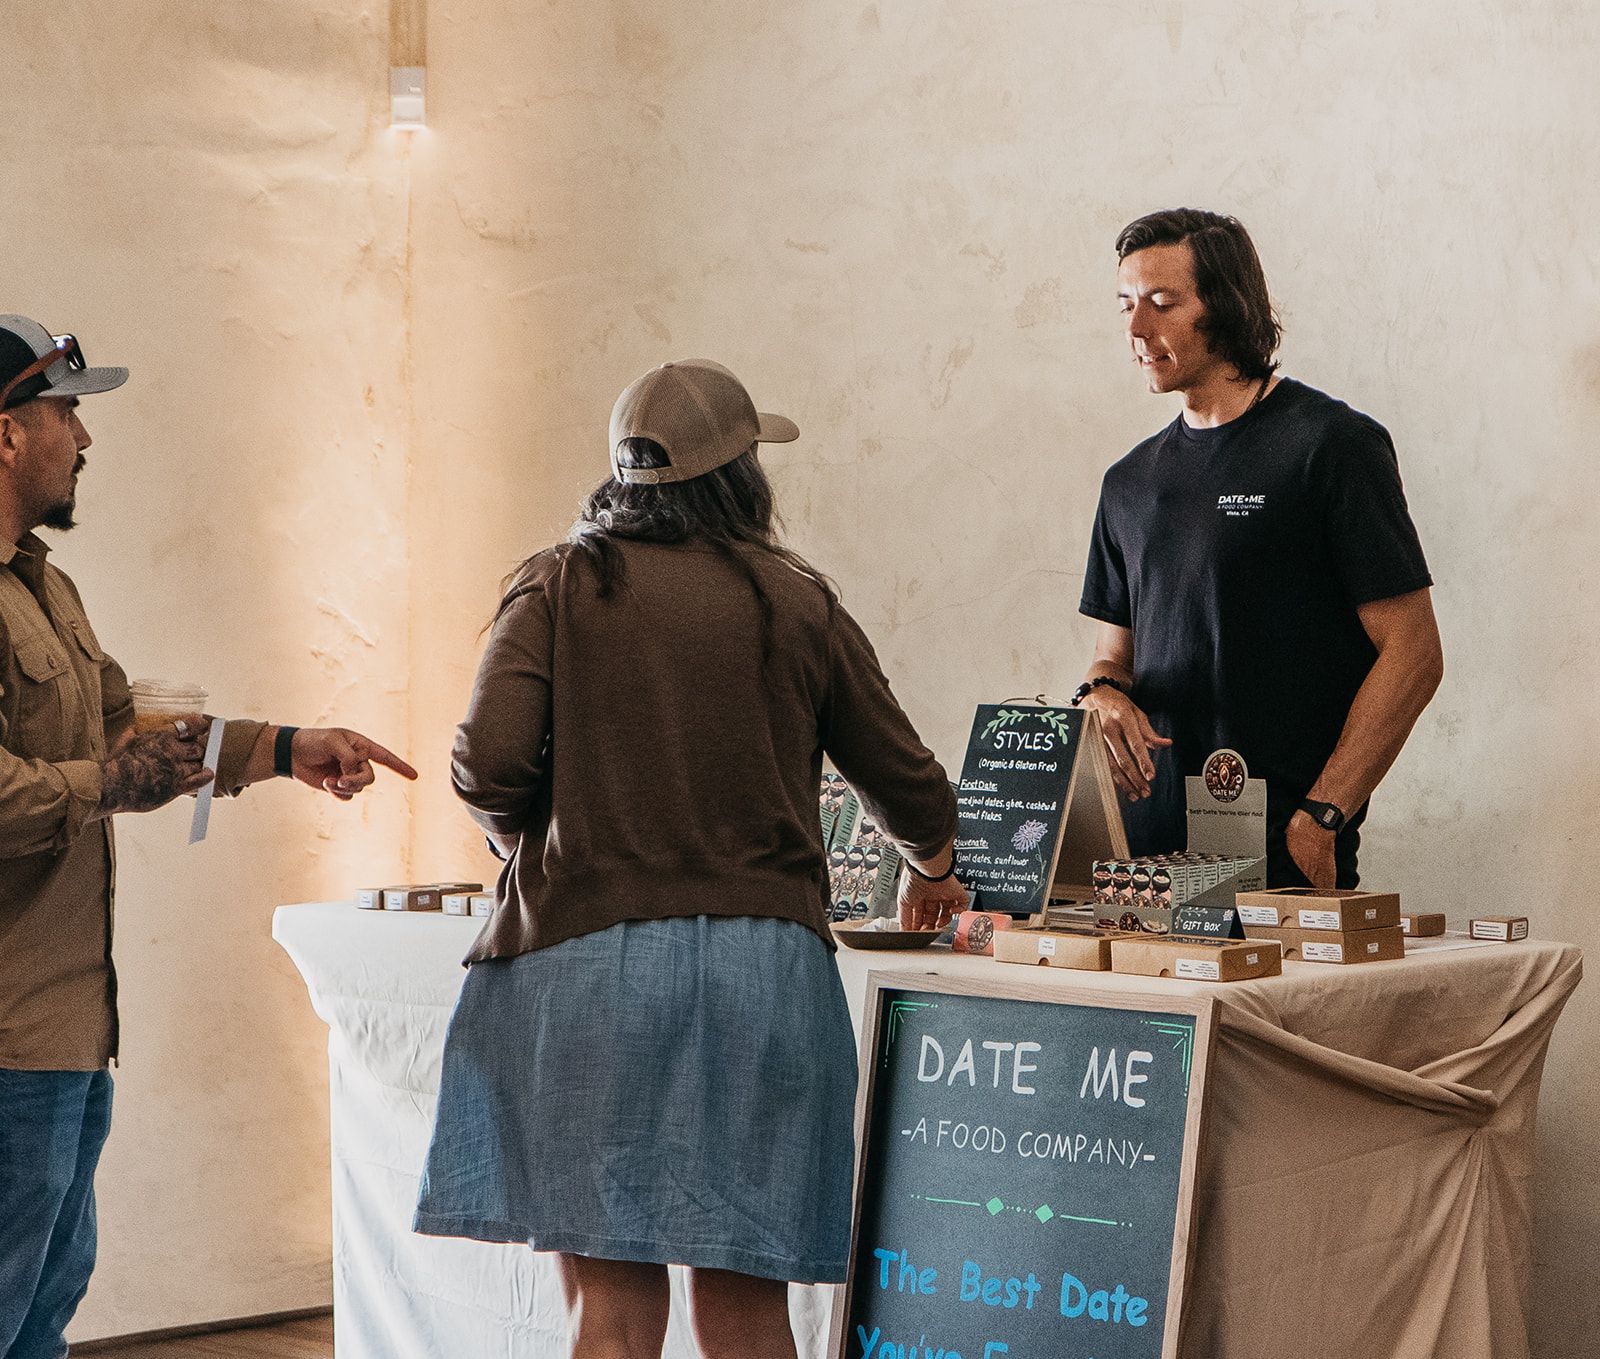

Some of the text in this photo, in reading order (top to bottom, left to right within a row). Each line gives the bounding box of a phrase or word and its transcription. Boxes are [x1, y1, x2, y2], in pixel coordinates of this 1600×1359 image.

[993, 730, 1055, 751] STYLES
[978, 758, 1008, 771] (Organic
[1015, 760, 1037, 770] Gluten
[1038, 761, 1057, 772] Free)
[1026, 801, 1049, 810] cashew
[980, 810, 1002, 821] flakes
[994, 854, 1029, 866] sunflower
[989, 869, 1005, 879] dark
[977, 883, 1001, 892] coconut
[1002, 882, 1026, 893] flakes
[1183, 921, 1221, 932] GIFT BOX
[916, 1034, 1154, 1108] DATE ME
[937, 1120, 1007, 1154] FOOD
[873, 1247, 1149, 1327] The Best Date
